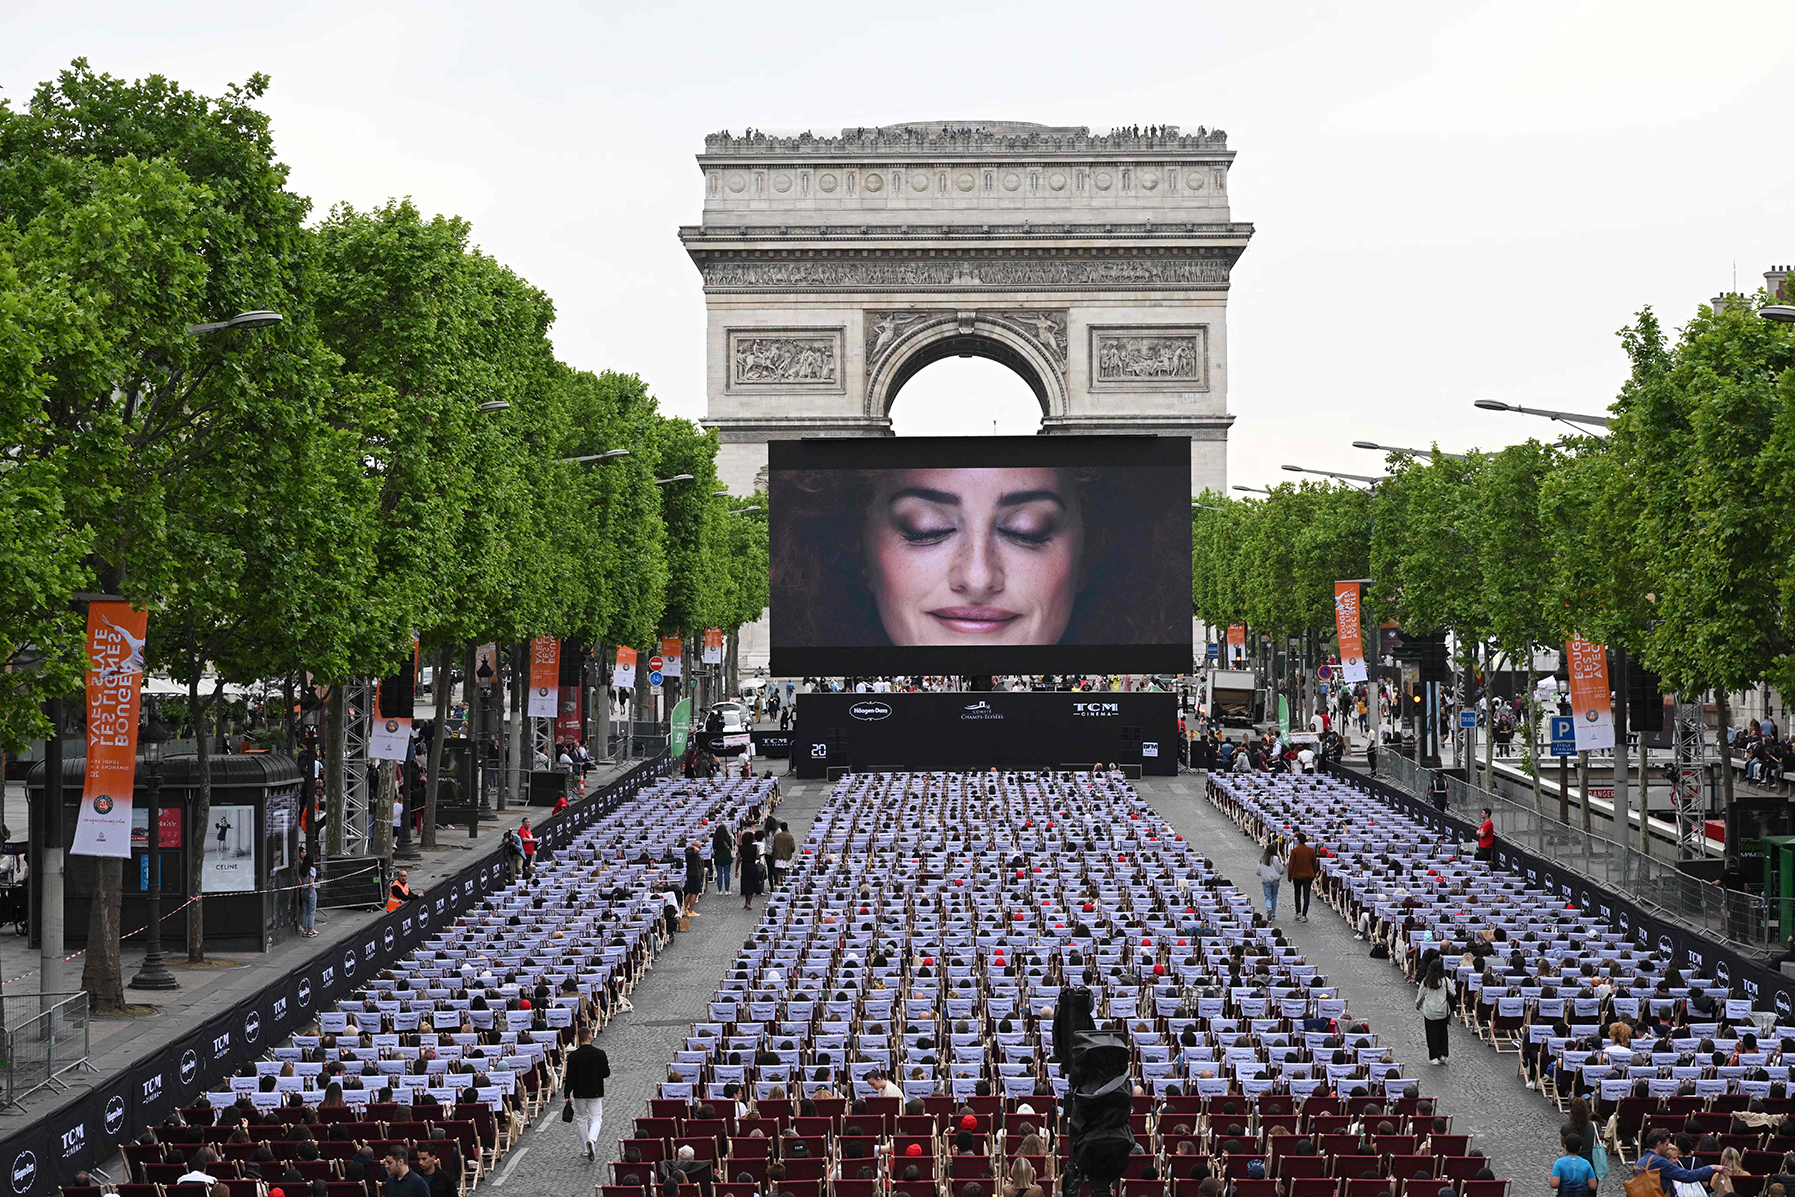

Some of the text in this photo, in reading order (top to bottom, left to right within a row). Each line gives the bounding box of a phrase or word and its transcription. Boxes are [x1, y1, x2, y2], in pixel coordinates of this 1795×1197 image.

[1073, 702, 1118, 712] TCM
[1559, 721, 1570, 737] P
[811, 743, 827, 757] 20
[1687, 949, 1703, 966] TCM
[1742, 978, 1759, 995] TCM
[273, 996, 287, 1015] TCM
[212, 1032, 230, 1053] TCM
[142, 1073, 162, 1096] TCM
[60, 1123, 86, 1150] TCM
